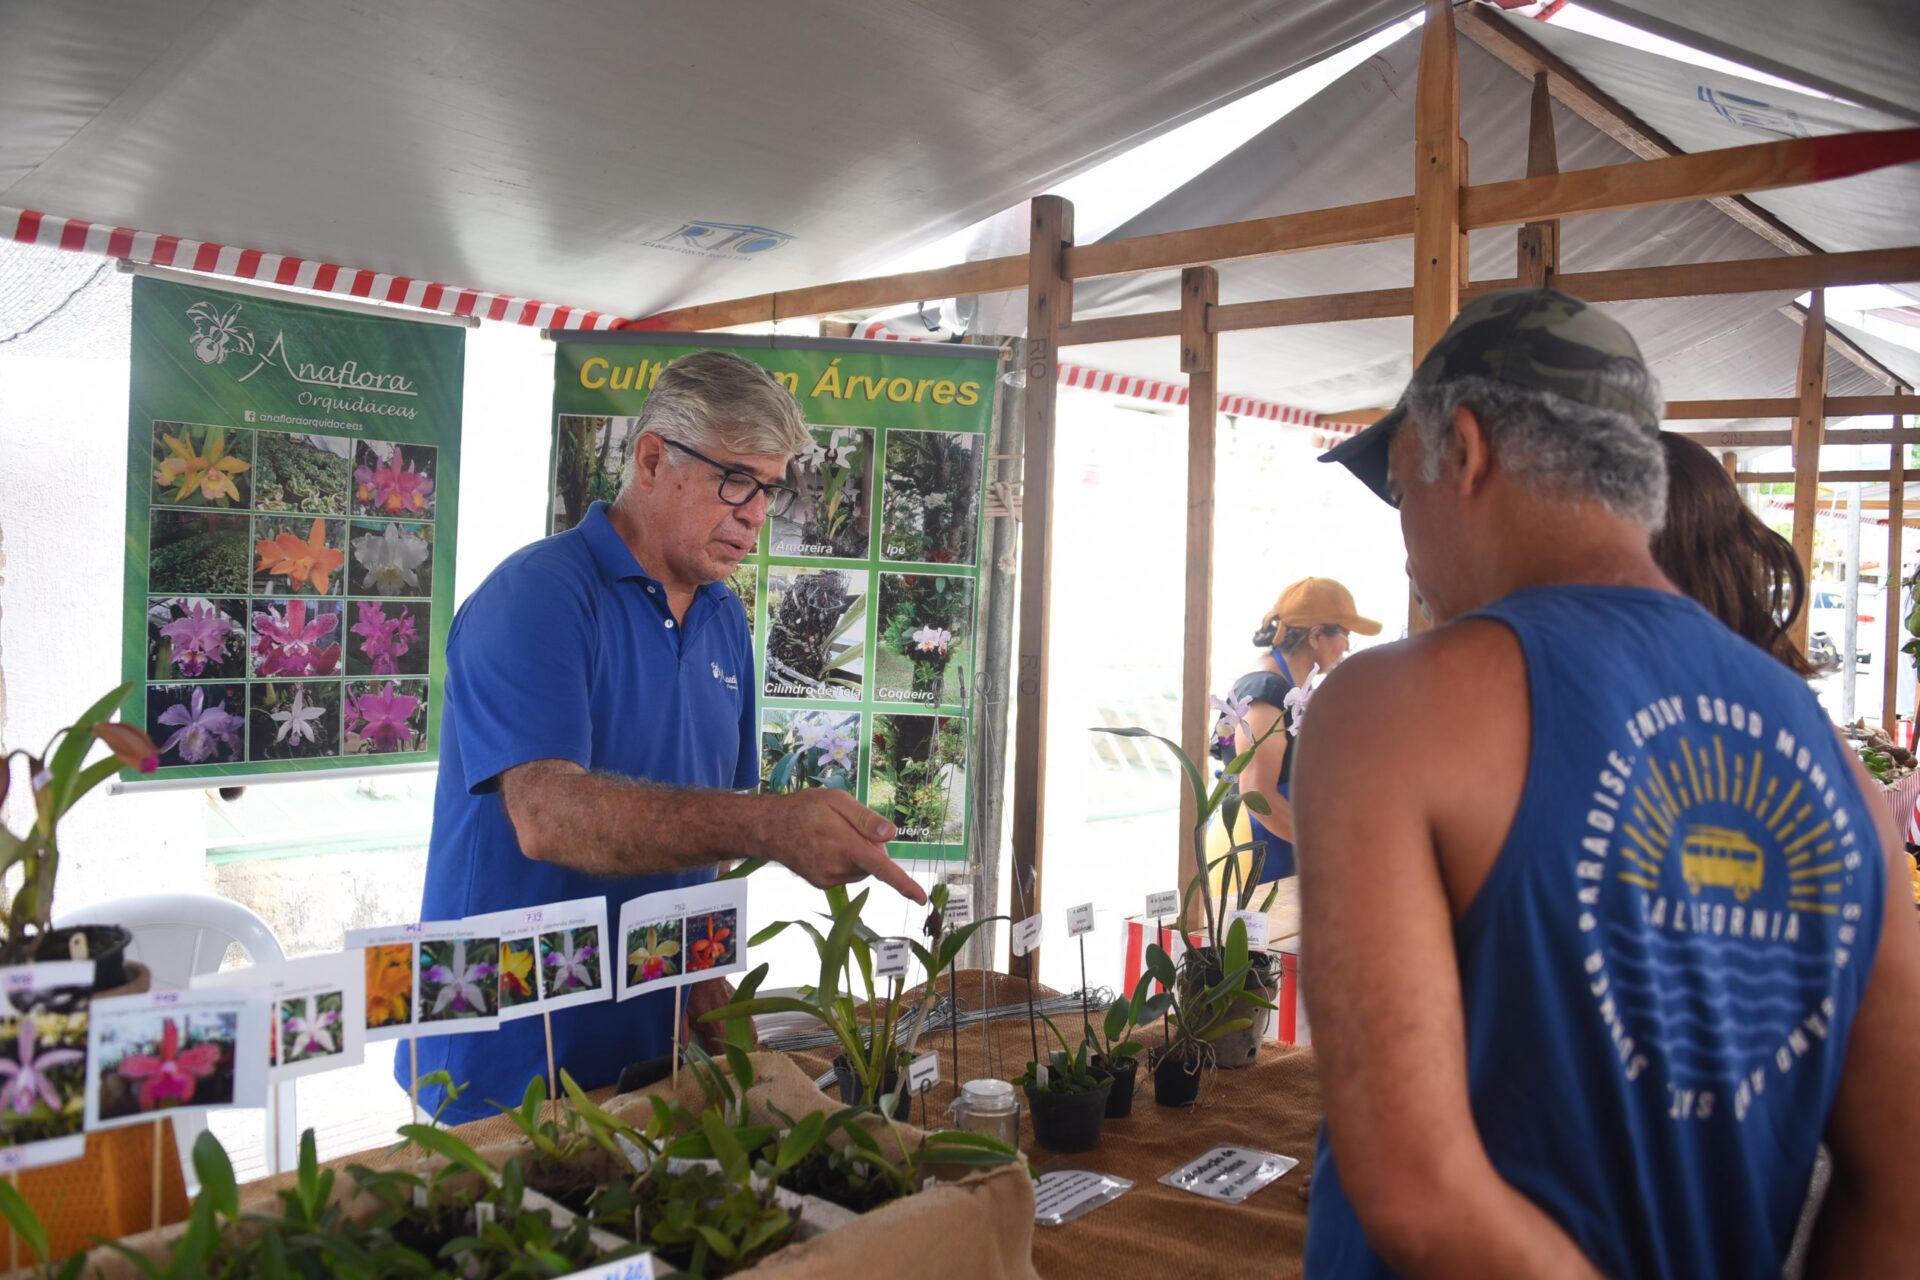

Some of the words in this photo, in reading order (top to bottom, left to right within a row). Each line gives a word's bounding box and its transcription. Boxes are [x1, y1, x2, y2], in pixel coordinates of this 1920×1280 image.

[238, 329, 418, 396] Anaflora
[1030, 338, 1047, 380] RIO
[809, 357, 981, 407] Árvores
[259, 413, 364, 431] anafloraorquidaceas
[775, 541, 834, 554] Amoreira
[764, 680, 814, 696] Cilindro
[817, 685, 834, 696] de
[836, 686, 862, 698] Tela
[878, 687, 935, 701] Coqueiro
[1625, 695, 1686, 748] ENJOY
[1697, 694, 1763, 739] GOOD
